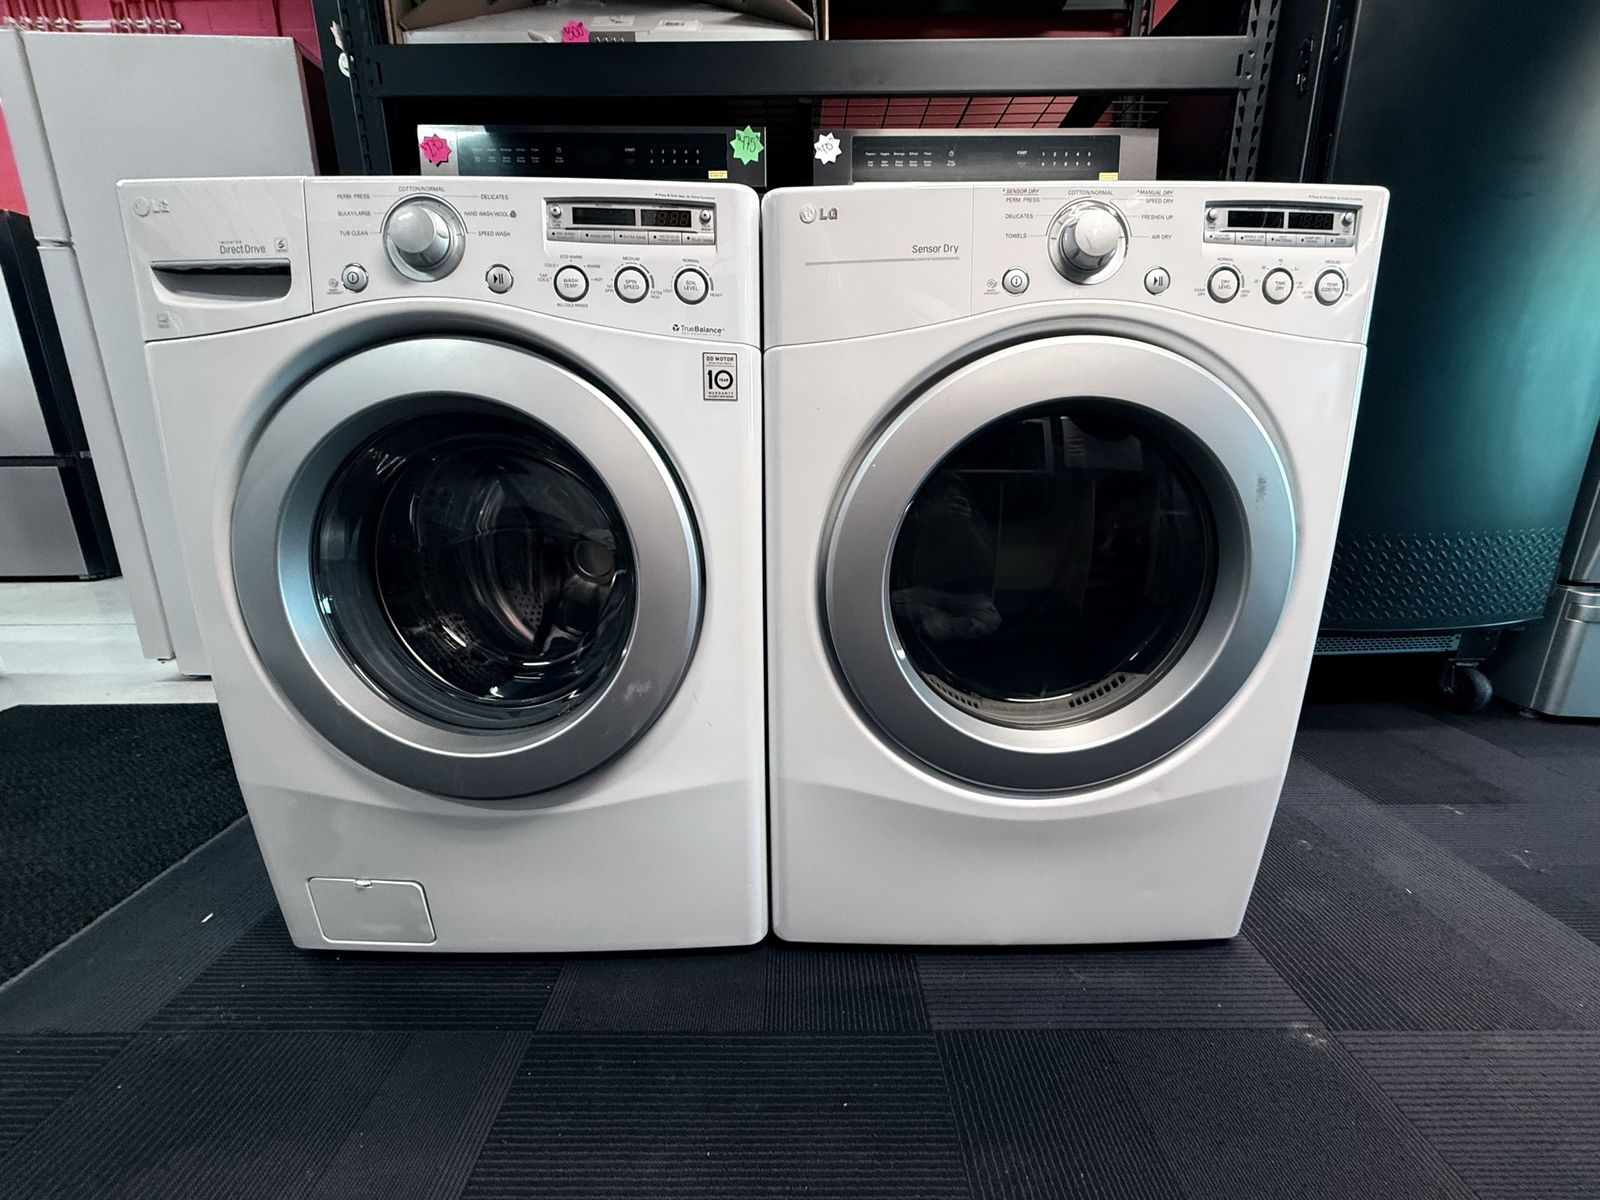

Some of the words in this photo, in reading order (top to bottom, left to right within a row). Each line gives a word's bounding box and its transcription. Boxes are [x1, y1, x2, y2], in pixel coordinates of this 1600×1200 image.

[819, 207, 838, 220] LG
[912, 244, 942, 254] Sensor
[943, 243, 959, 256] Dry
